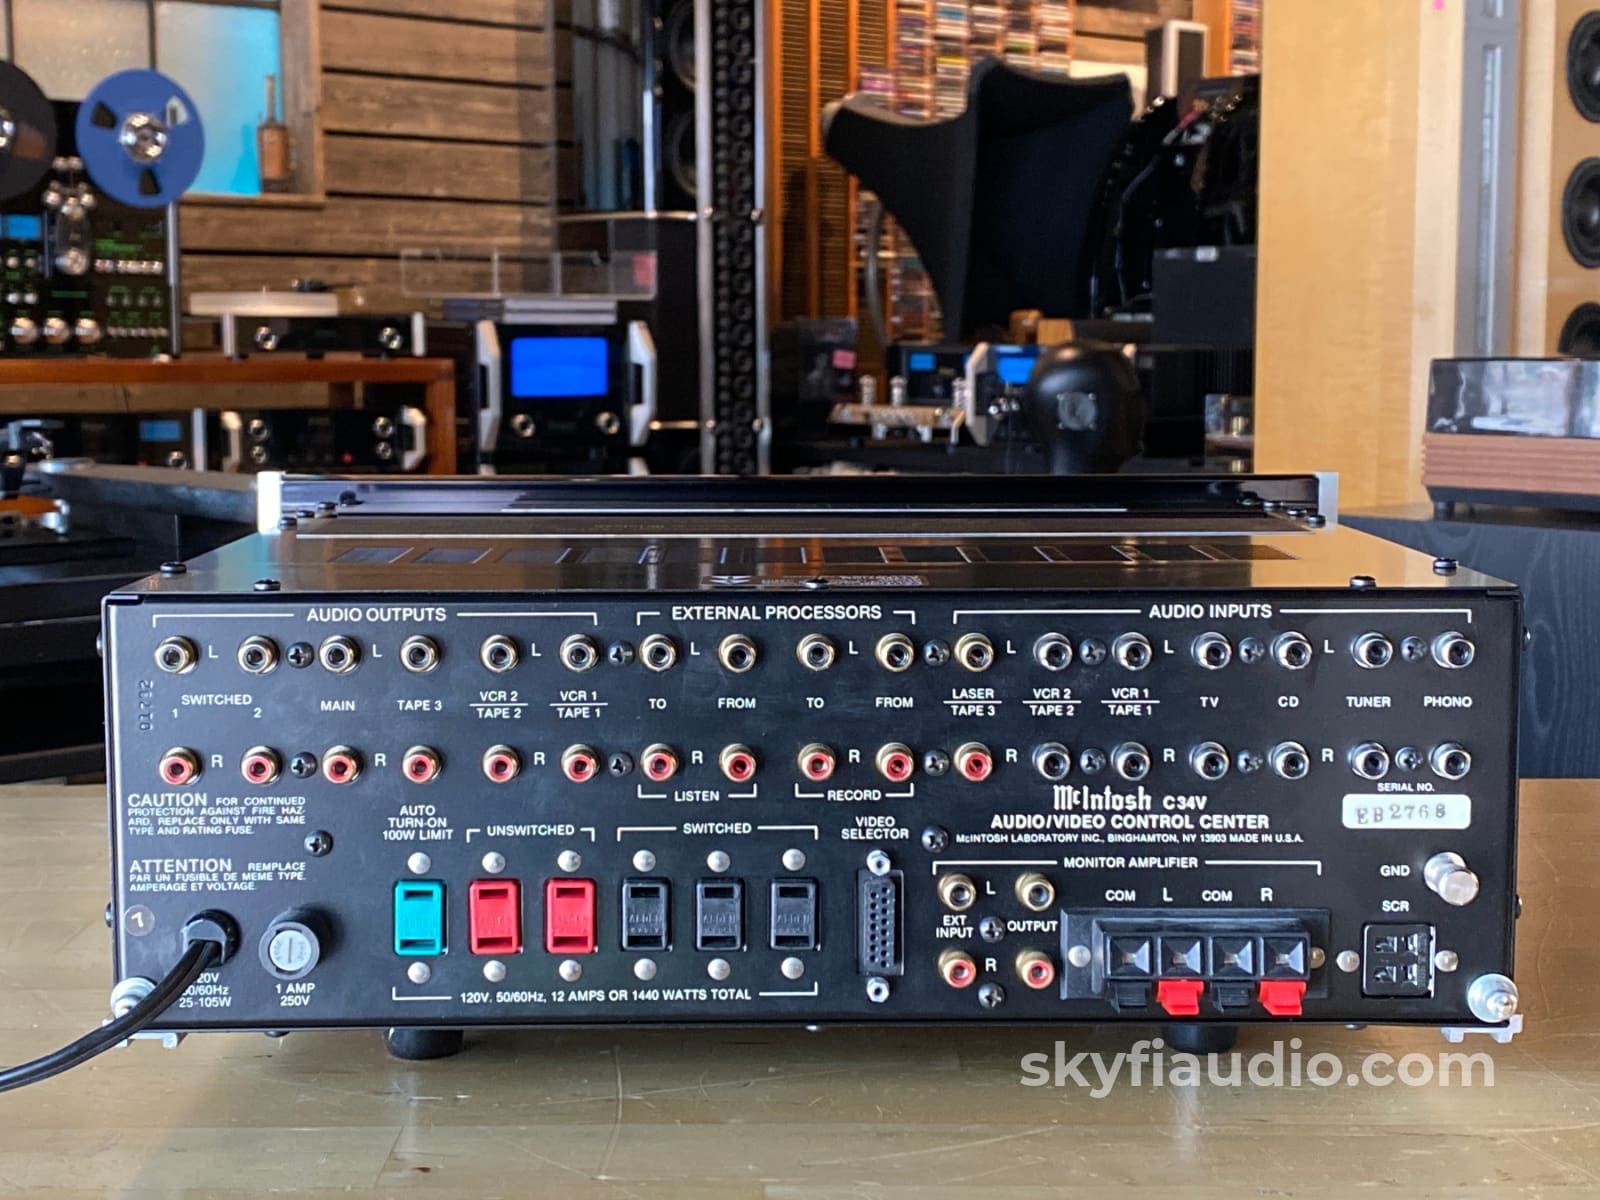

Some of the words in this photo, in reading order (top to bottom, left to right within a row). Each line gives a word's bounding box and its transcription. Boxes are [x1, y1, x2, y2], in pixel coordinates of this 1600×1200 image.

[306, 607, 363, 623] AUDIO
[366, 607, 447, 622] OUTPUTS
[671, 605, 762, 621] EXTERNAL
[765, 604, 882, 620] PROCESSORS
[1148, 603, 1205, 619] AUDIO
[1209, 603, 1273, 619] INPUTS
[208, 644, 219, 659] L
[372, 643, 383, 658] L
[531, 642, 542, 657] L
[690, 641, 701, 656] L
[848, 640, 859, 655] L
[1006, 639, 1017, 654] L
[1163, 639, 1175, 654] L
[1324, 639, 1335, 654] L
[181, 693, 253, 706] SWITCHED
[479, 690, 507, 702] VCR
[510, 690, 519, 702] 2
[559, 690, 587, 702] VCR
[591, 690, 597, 701] 1
[952, 687, 995, 700] LASER
[1032, 687, 1061, 700] VCR
[1063, 687, 1074, 700] 2
[1111, 687, 1140, 700] VCR
[1142, 687, 1151, 700] 1
[320, 700, 356, 712] MAIN
[396, 699, 431, 711] TAPE
[434, 699, 443, 711] 3
[648, 697, 667, 710] TO
[717, 697, 756, 709] FROM
[806, 696, 825, 709] TO
[875, 696, 914, 709] FROM
[1199, 696, 1219, 708] TV
[1277, 695, 1300, 708] CD
[1345, 695, 1392, 708] TUNER
[1423, 695, 1473, 708] PHONO
[172, 708, 178, 719] 1
[253, 706, 262, 719] 2
[476, 707, 510, 719] TAPE
[513, 707, 522, 719] 2
[556, 706, 590, 719] TAPE
[594, 707, 601, 718] 1
[950, 704, 985, 717] TAPE
[987, 704, 996, 717] 3
[1029, 704, 1063, 717] TAPE
[1066, 704, 1075, 717] 2
[1107, 704, 1142, 716] TAPE
[1145, 704, 1152, 716] 1
[211, 754, 224, 768] R
[374, 752, 387, 767] R
[533, 751, 546, 766] R
[691, 750, 704, 765] R
[848, 748, 861, 763] R
[1005, 748, 1018, 763] R
[1163, 748, 1176, 763] R
[1321, 747, 1334, 763] R
[1377, 782, 1415, 793] SERIAL
[1416, 782, 1435, 792] NO.
[127, 793, 208, 807] CAUTION
[215, 797, 239, 806] FOR
[243, 797, 306, 807] CONTINUED
[674, 790, 720, 802] LISTEN
[827, 789, 882, 802] RECORD
[1162, 795, 1208, 811] C34V
[127, 808, 197, 818] PROTECTION
[199, 807, 247, 815] AGAINST
[251, 807, 276, 817] FIRE
[399, 804, 436, 818] AUTO
[157, 817, 206, 827] REPLACE
[209, 816, 242, 827] ONLY
[243, 816, 272, 824] WITH
[275, 816, 306, 824] SAME
[387, 816, 450, 832] TURN-ON
[855, 815, 897, 830] VIDEO
[990, 813, 1106, 830] AUDIO/VIDEO
[1110, 813, 1195, 830] CONTROL
[1199, 814, 1270, 830] CENTER
[127, 826, 154, 835] TYPE
[156, 827, 181, 835] AND
[182, 826, 223, 834] RATING
[382, 829, 416, 841] 100W
[419, 828, 454, 841] LIMIT
[486, 823, 575, 837] UNSWITCHED
[682, 822, 752, 835] SWITCHED
[841, 827, 910, 840] SELECTOR
[955, 833, 1009, 844] McINTOSH
[1010, 833, 1079, 843] LABORATORY
[1107, 833, 1180, 844] BINGHAMTON,
[1182, 833, 1197, 843] NY
[1228, 833, 1259, 843] MADE
[1261, 833, 1273, 843] IN
[1274, 833, 1304, 843] U.S.A.
[129, 859, 231, 873] ATTENTION
[247, 862, 306, 873] REMPLACE
[1063, 856, 1126, 869] MONITOR
[1128, 856, 1199, 869] AMPLIFIER
[1379, 864, 1411, 877] GND
[129, 874, 151, 882] PAR
[154, 874, 171, 882] UN
[175, 873, 220, 883] FUSIBLE
[223, 872, 238, 883] DE
[241, 872, 274, 881] MEME
[129, 883, 188, 891] AMPERAGE
[190, 882, 204, 891] ET
[985, 880, 997, 895] L
[1105, 889, 1136, 902] COM
[1162, 887, 1174, 902] L
[1201, 889, 1233, 902] COM
[1260, 887, 1273, 902] R
[1381, 899, 1410, 913] SCR
[942, 914, 968, 927] EXT
[1006, 919, 1059, 933] OUTPUT
[935, 926, 974, 939] INPUT
[985, 957, 997, 972] R
[196, 972, 220, 984] 20V
[275, 983, 282, 994] 1
[285, 982, 316, 997] AMP
[495, 991, 547, 1003] 50/60Hz,
[551, 990, 565, 1003] 12
[567, 989, 606, 1002] AMPS
[608, 989, 628, 1002] OR
[631, 988, 660, 1001] 1440
[661, 988, 708, 1001] WATTS
[710, 988, 752, 1001] TOTAL
[178, 996, 232, 1009] 25-105W
[279, 994, 311, 1007] 250V
